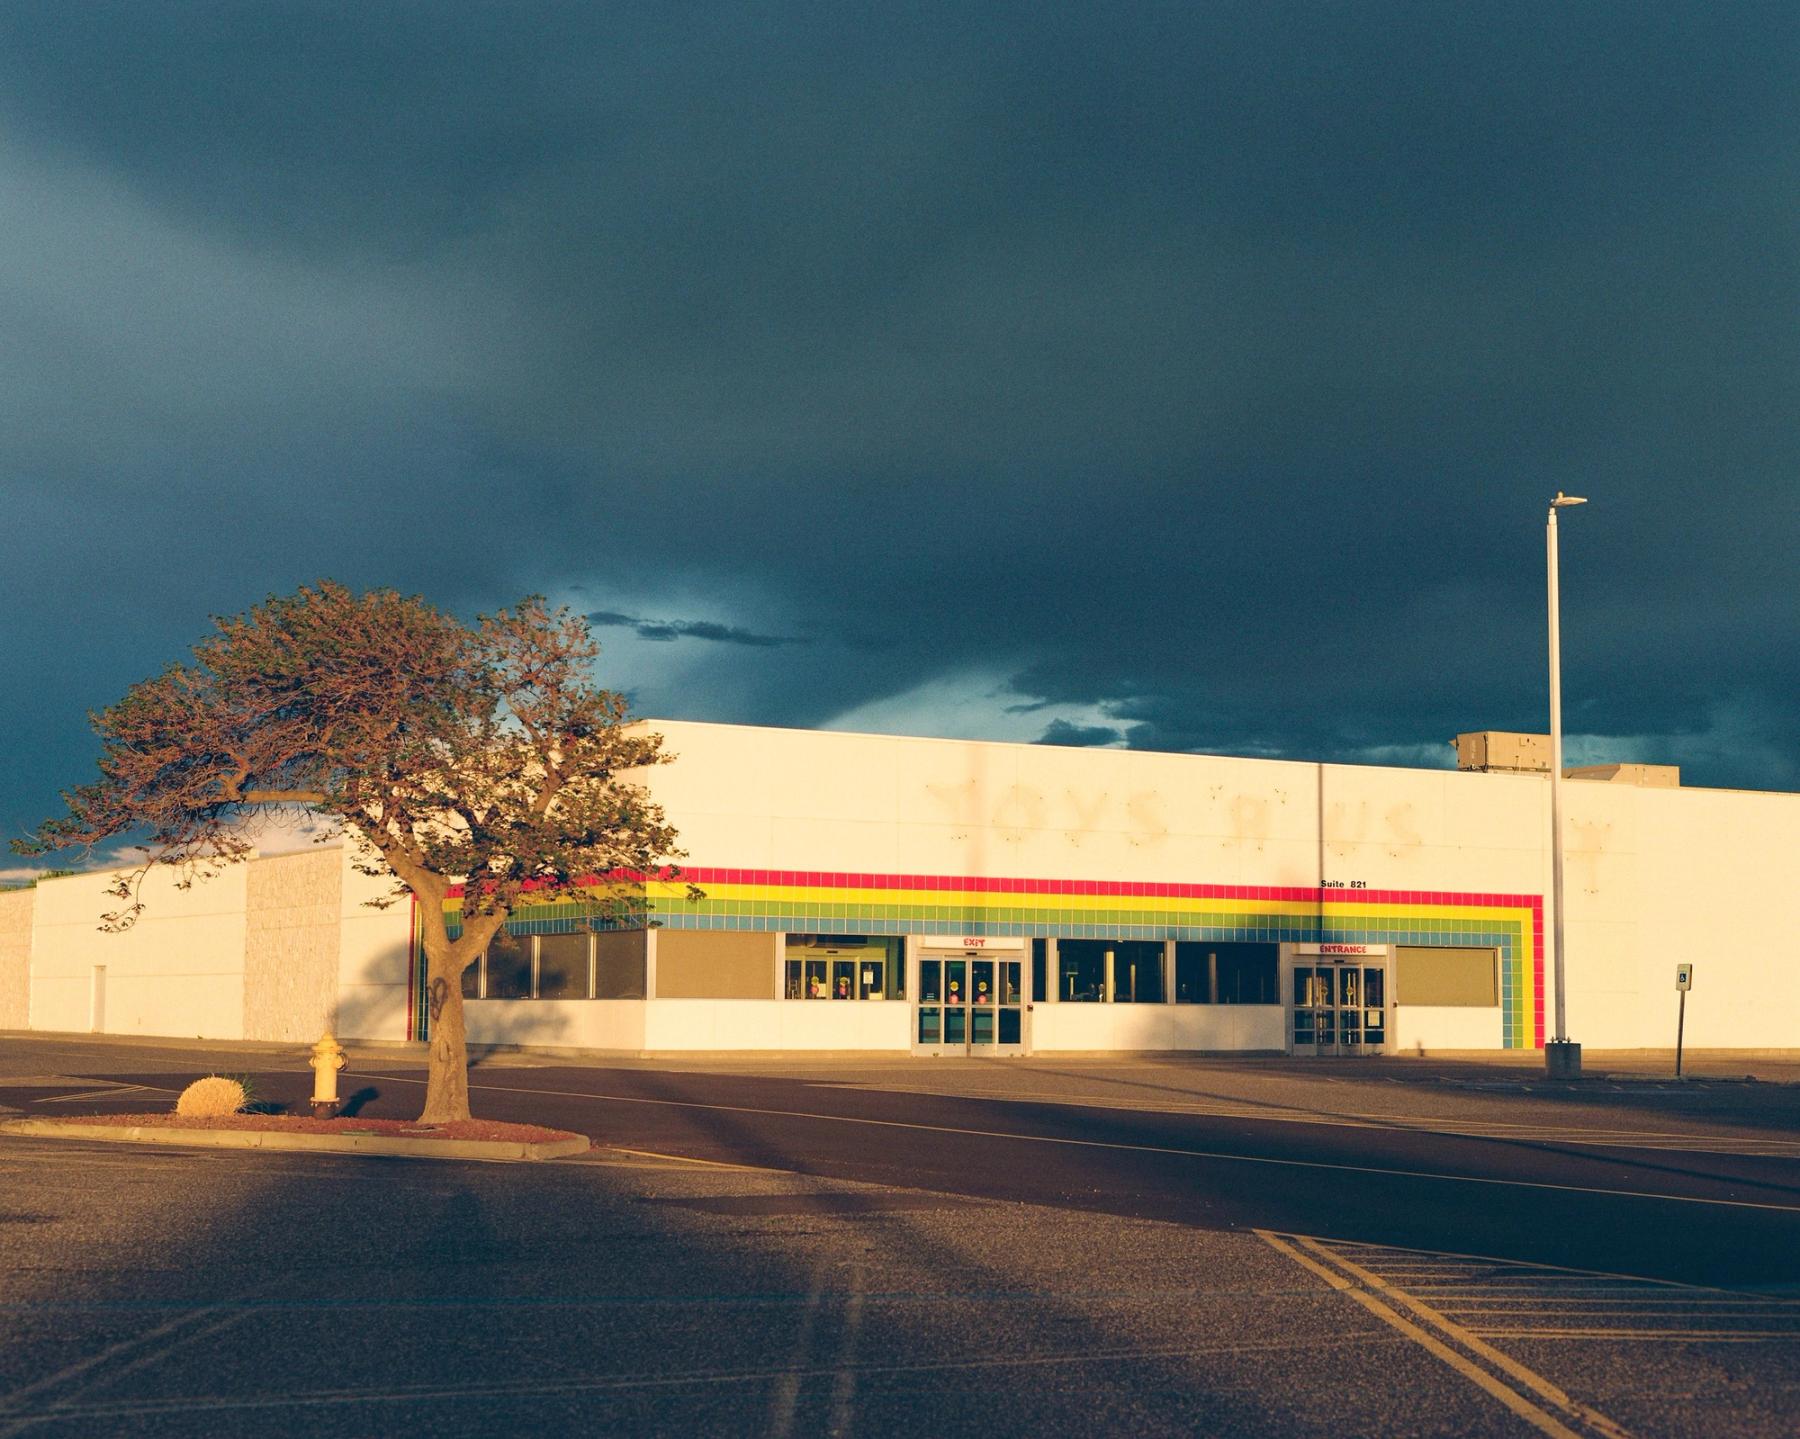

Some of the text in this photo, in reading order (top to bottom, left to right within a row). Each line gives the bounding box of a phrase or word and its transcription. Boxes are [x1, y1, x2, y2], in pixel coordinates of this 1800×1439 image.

[1320, 879, 1367, 889] Suite 821
[1319, 944, 1367, 954] ENTRANCE
